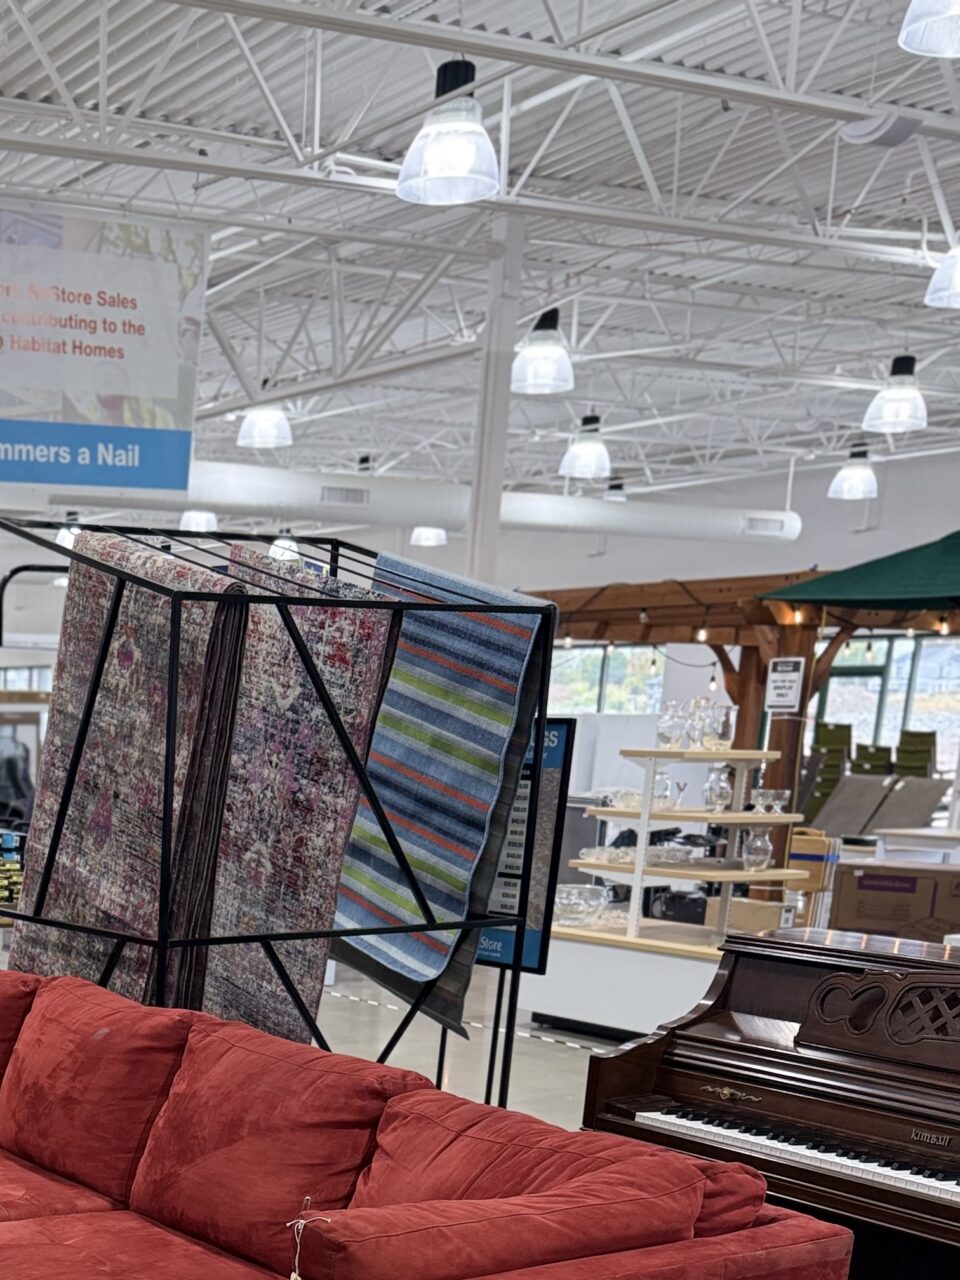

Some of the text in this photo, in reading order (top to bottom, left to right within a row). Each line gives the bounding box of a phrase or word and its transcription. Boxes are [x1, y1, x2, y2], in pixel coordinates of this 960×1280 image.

[29, 283, 92, 305] Store
[97, 290, 138, 310] Sales
[103, 318, 118, 334] to
[122, 319, 145, 336] the
[10, 335, 67, 354] Habitat
[72, 340, 125, 360] Homes
[77, 447, 90, 465] a
[97, 442, 139, 467] Nail
[480, 935, 503, 952] Store
